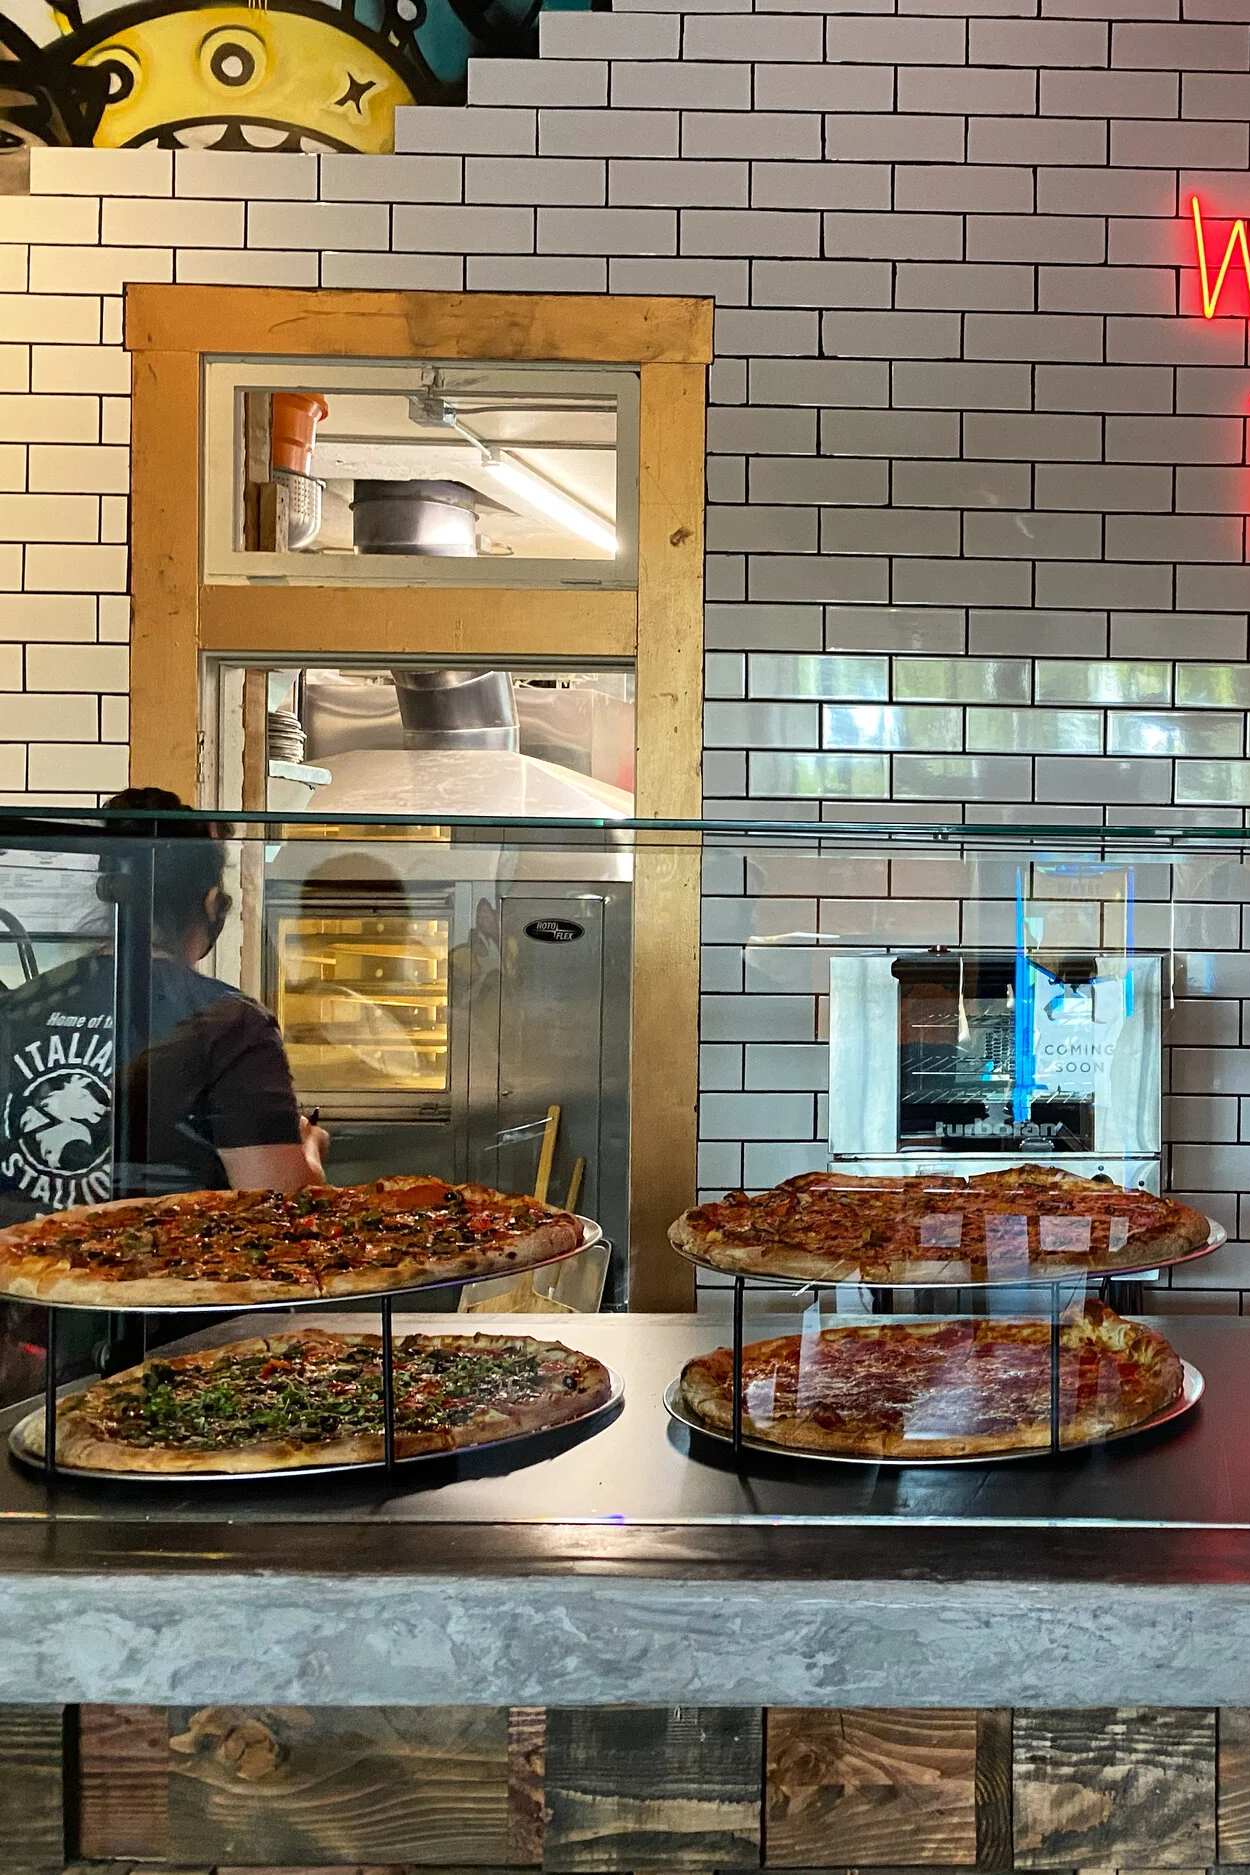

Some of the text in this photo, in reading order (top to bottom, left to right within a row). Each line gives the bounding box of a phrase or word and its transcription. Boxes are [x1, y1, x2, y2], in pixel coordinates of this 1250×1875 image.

[537, 922, 556, 930] ROTO
[556, 932, 573, 940] FLEX
[46, 1012, 86, 1028] Home
[87, 1014, 105, 1028] of
[13, 1032, 113, 1080] ITALIA
[1044, 1044, 1116, 1056] COMING
[1055, 1062, 1104, 1073] SOON
[935, 1118, 1058, 1138] turbofan
[1, 1152, 112, 1211] STALLIO
